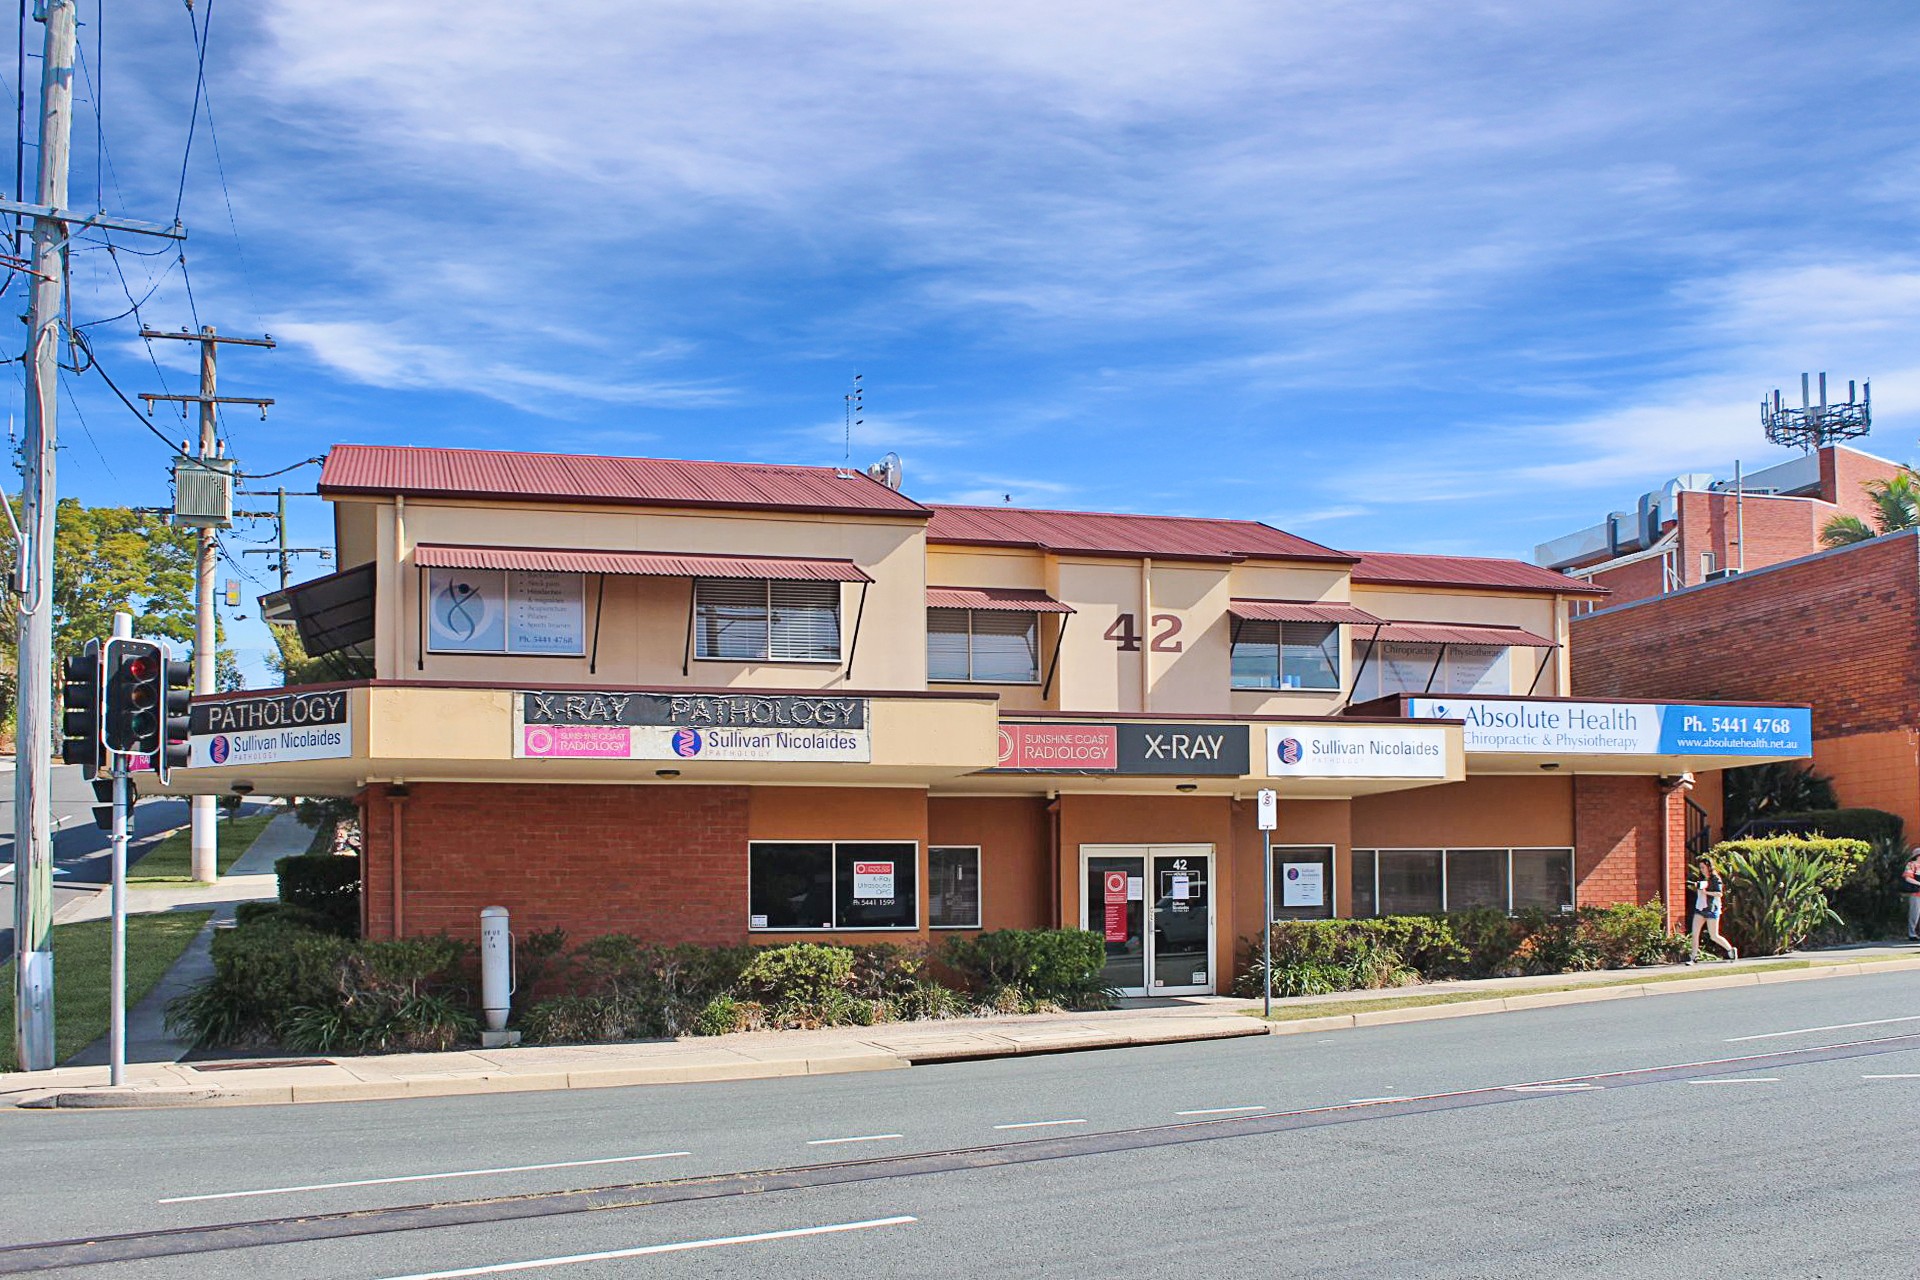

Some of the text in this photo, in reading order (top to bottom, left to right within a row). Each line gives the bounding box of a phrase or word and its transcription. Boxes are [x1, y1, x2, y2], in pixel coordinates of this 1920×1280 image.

[1104, 613, 1182, 652] 42
[209, 696, 341, 730] PATHOLOGY
[533, 696, 856, 724] X-RAY PATHOLOGY
[1464, 705, 1637, 731] Absolute Health
[1683, 716, 1790, 734] Ph. 5441 4768
[234, 729, 341, 753] Sullivan Nicolaides
[560, 741, 626, 751] RADIOLOGY
[599, 733, 626, 741] COAST
[708, 731, 857, 750] Sullivan Nicolaides
[1024, 734, 1109, 745] SUNSHINE COAST
[1463, 731, 1639, 751] Chiropractic & Physiotherapy
[1677, 737, 1798, 749] www.absolutehealth.net.au
[1024, 746, 1109, 760] RADIOLOGY
[1144, 734, 1223, 760] X-RAY
[1311, 739, 1439, 756] Sullivan Nicolaides
[234, 752, 277, 761] PATHOLOGY
[1172, 859, 1188, 870] 42
